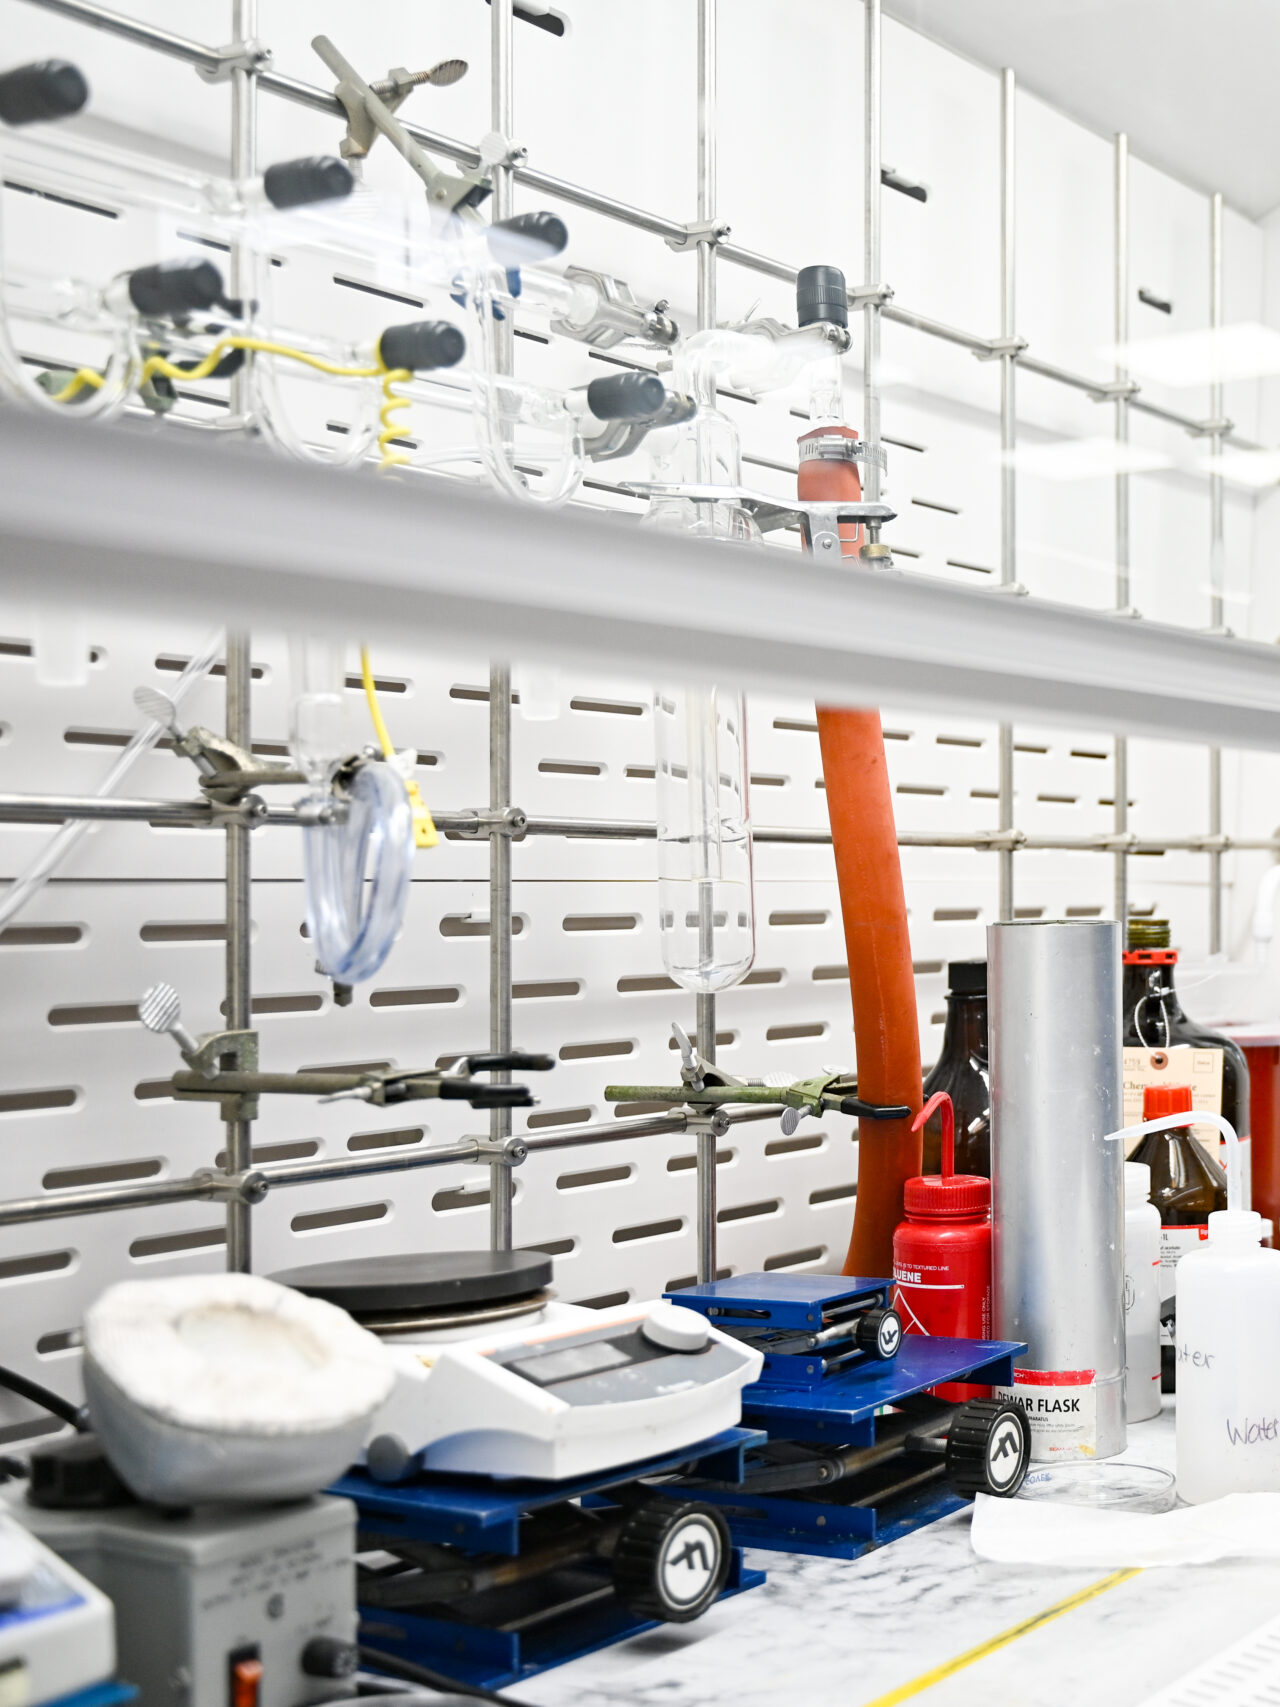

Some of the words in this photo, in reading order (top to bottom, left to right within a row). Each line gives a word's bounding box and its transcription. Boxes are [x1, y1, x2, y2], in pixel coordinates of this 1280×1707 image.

[893, 1267, 922, 1283] LUENE
[1177, 1343, 1215, 1369] ater
[1037, 1397, 1080, 1413] FLASK
[1226, 1417, 1279, 1446] Water
